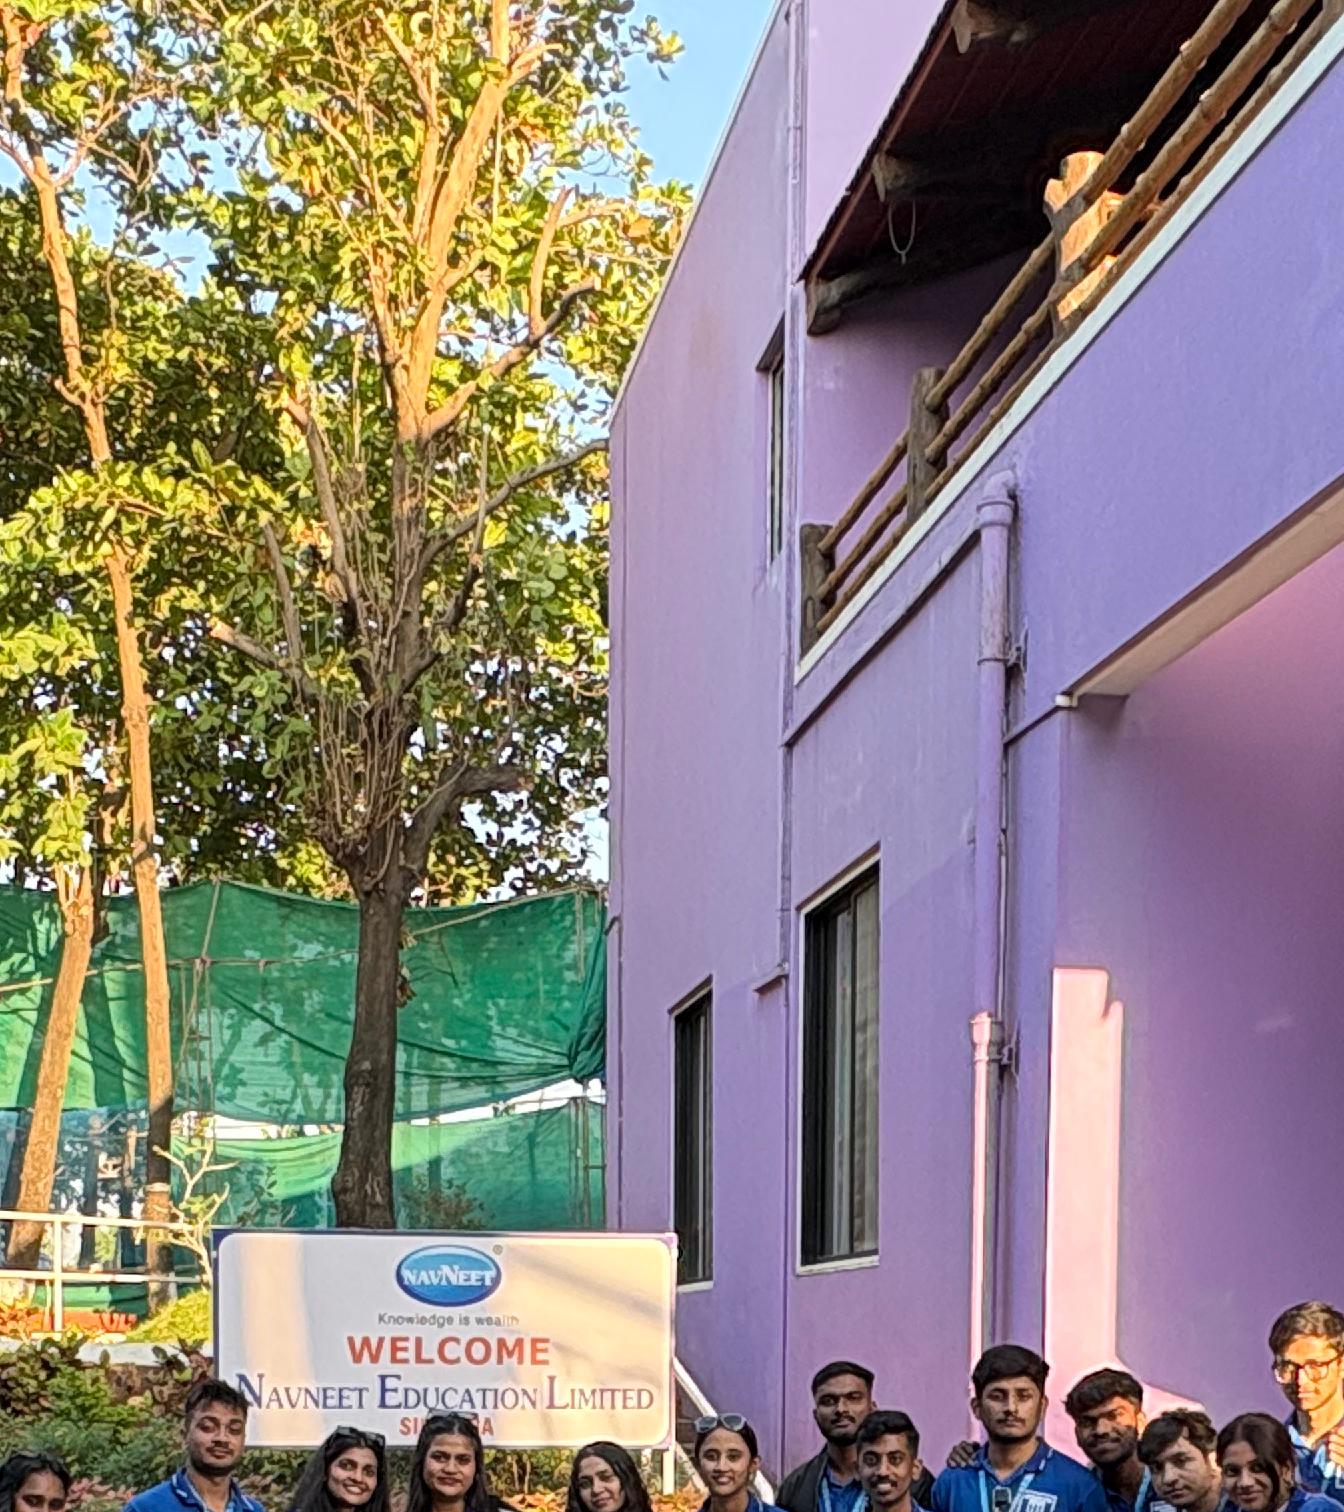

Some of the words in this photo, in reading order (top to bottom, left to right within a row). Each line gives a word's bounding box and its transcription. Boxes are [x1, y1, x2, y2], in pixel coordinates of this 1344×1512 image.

[377, 1312, 455, 1329] Knowledge
[458, 1313, 471, 1326] is
[346, 1336, 551, 1365] WELCOME
[235, 1373, 370, 1410] NAVNEET
[377, 1374, 537, 1410] EDUCATION
[546, 1375, 655, 1410] LIMITED
